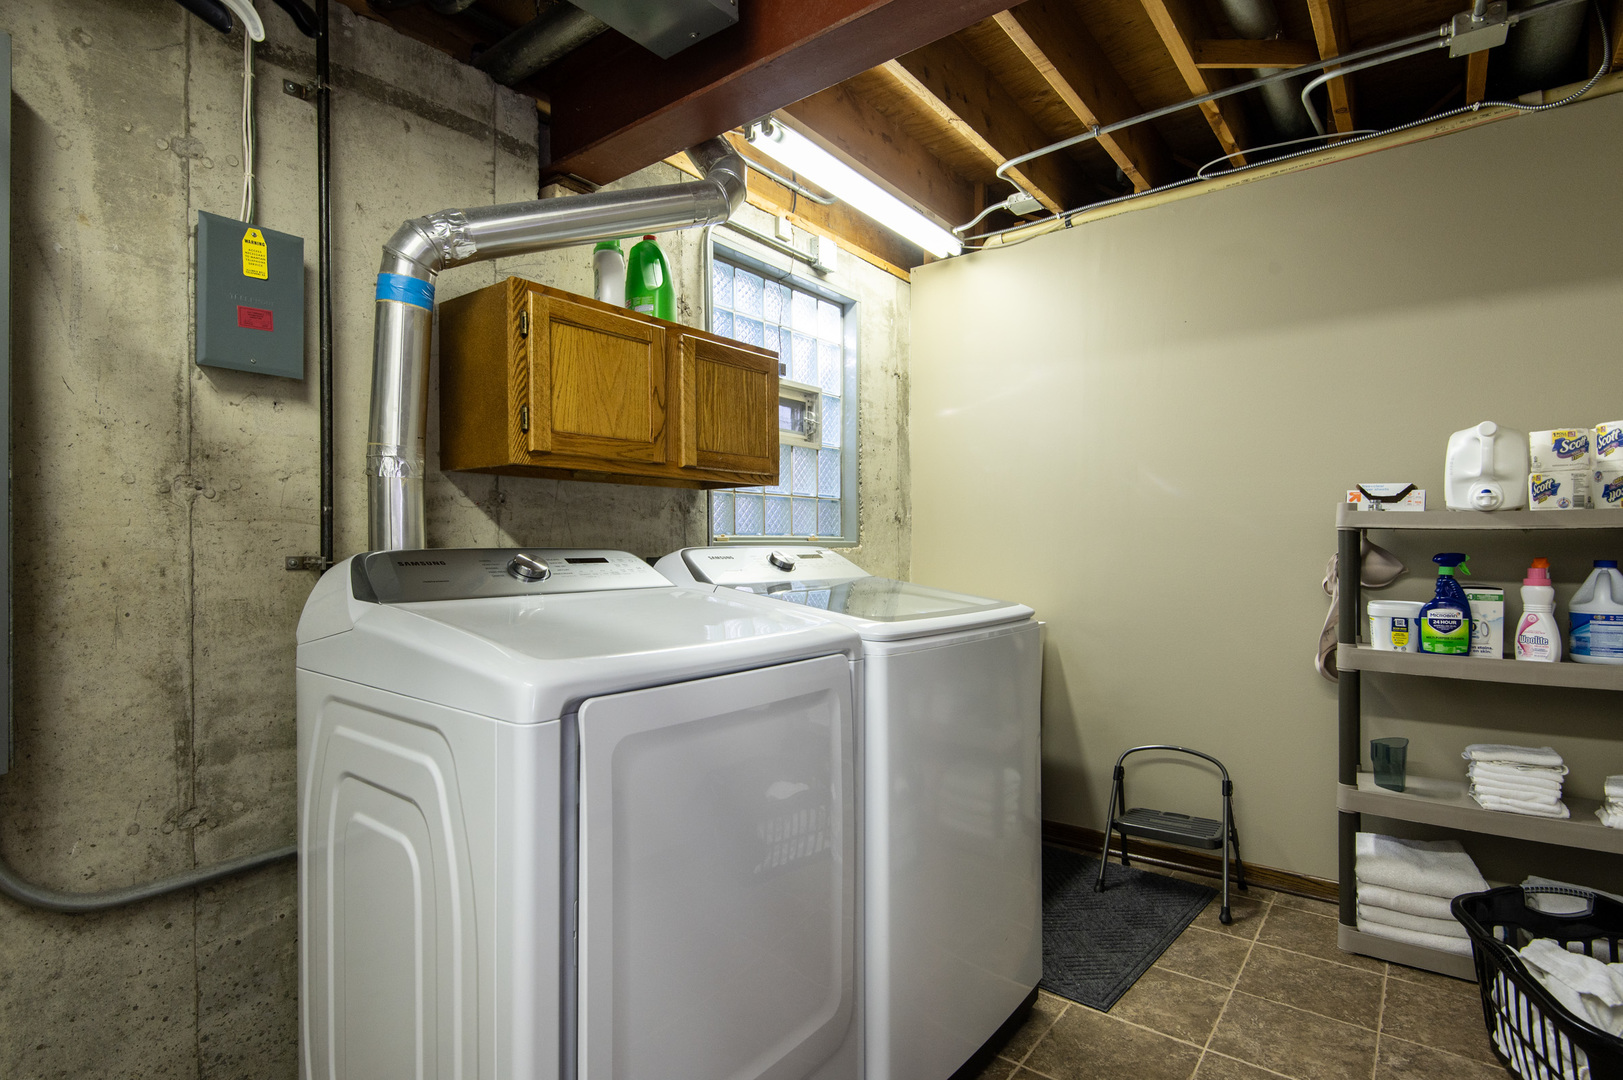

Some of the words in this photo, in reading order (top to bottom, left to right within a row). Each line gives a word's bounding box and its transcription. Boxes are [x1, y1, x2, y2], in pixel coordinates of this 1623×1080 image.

[244, 239, 265, 247] WARNING
[1559, 435, 1587, 453] Scott
[1598, 428, 1621, 450] Scott
[1532, 479, 1553, 496] Scott
[1519, 634, 1549, 646] Woolite
